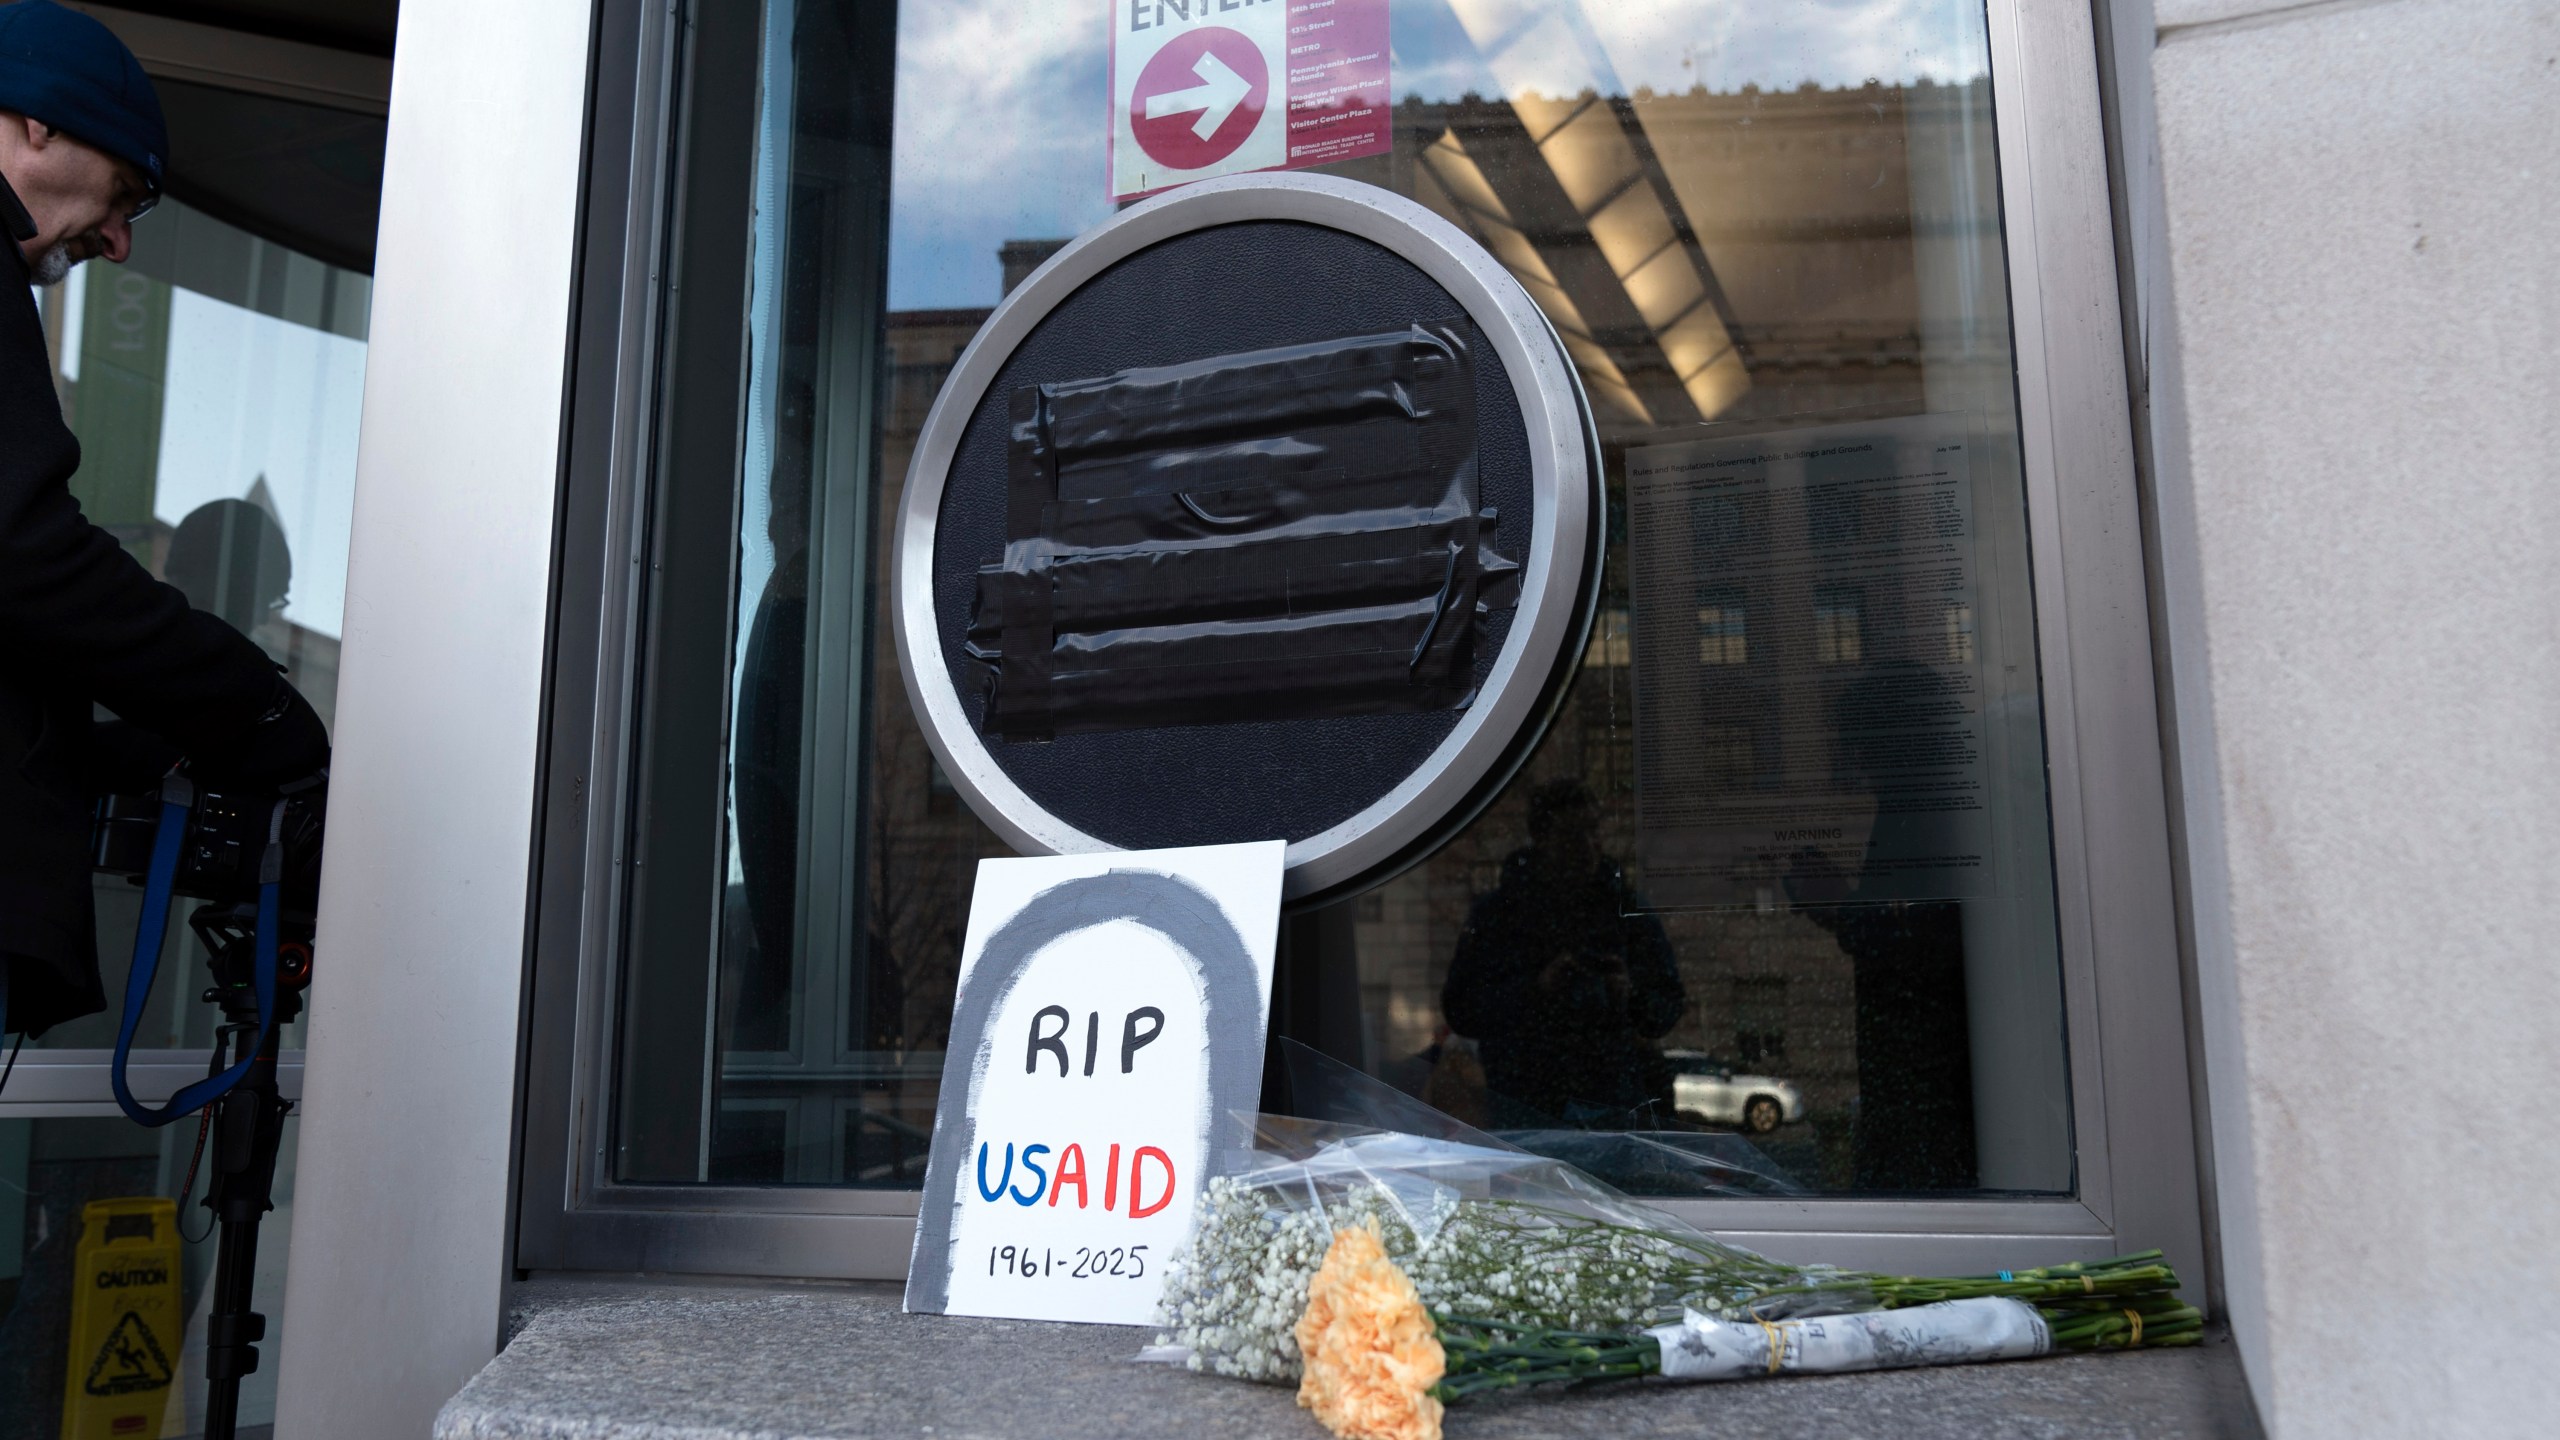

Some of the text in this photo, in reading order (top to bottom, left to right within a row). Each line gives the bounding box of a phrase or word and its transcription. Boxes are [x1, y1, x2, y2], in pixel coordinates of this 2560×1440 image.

[1291, 0, 1335, 13] 14th Street
[1308, 19, 1335, 31] Street
[1291, 43, 1320, 55] METRO
[1291, 59, 1345, 76] Pennsylvania
[1291, 71, 1325, 84] Rotunda
[1291, 90, 1328, 102] Woodrow
[1329, 83, 1358, 94] Wilson
[1291, 100, 1315, 110] Berlin
[1316, 95, 1335, 105] Wall
[1291, 118, 1318, 129] Visitor
[1320, 112, 1348, 123] Center
[1349, 108, 1372, 118] Plaza
[1633, 443, 1872, 477] Rules and Regulations Governing Public Buildings and Grounds
[1774, 828, 1842, 841] WARNING
[1758, 849, 1862, 862] WEAPONS PROHIBITED
[1025, 1004, 1166, 1079] RIP
[976, 1140, 1176, 1219] USAID
[988, 1244, 1151, 1280] 1961-2025
[96, 1267, 168, 1289] CAUTION
